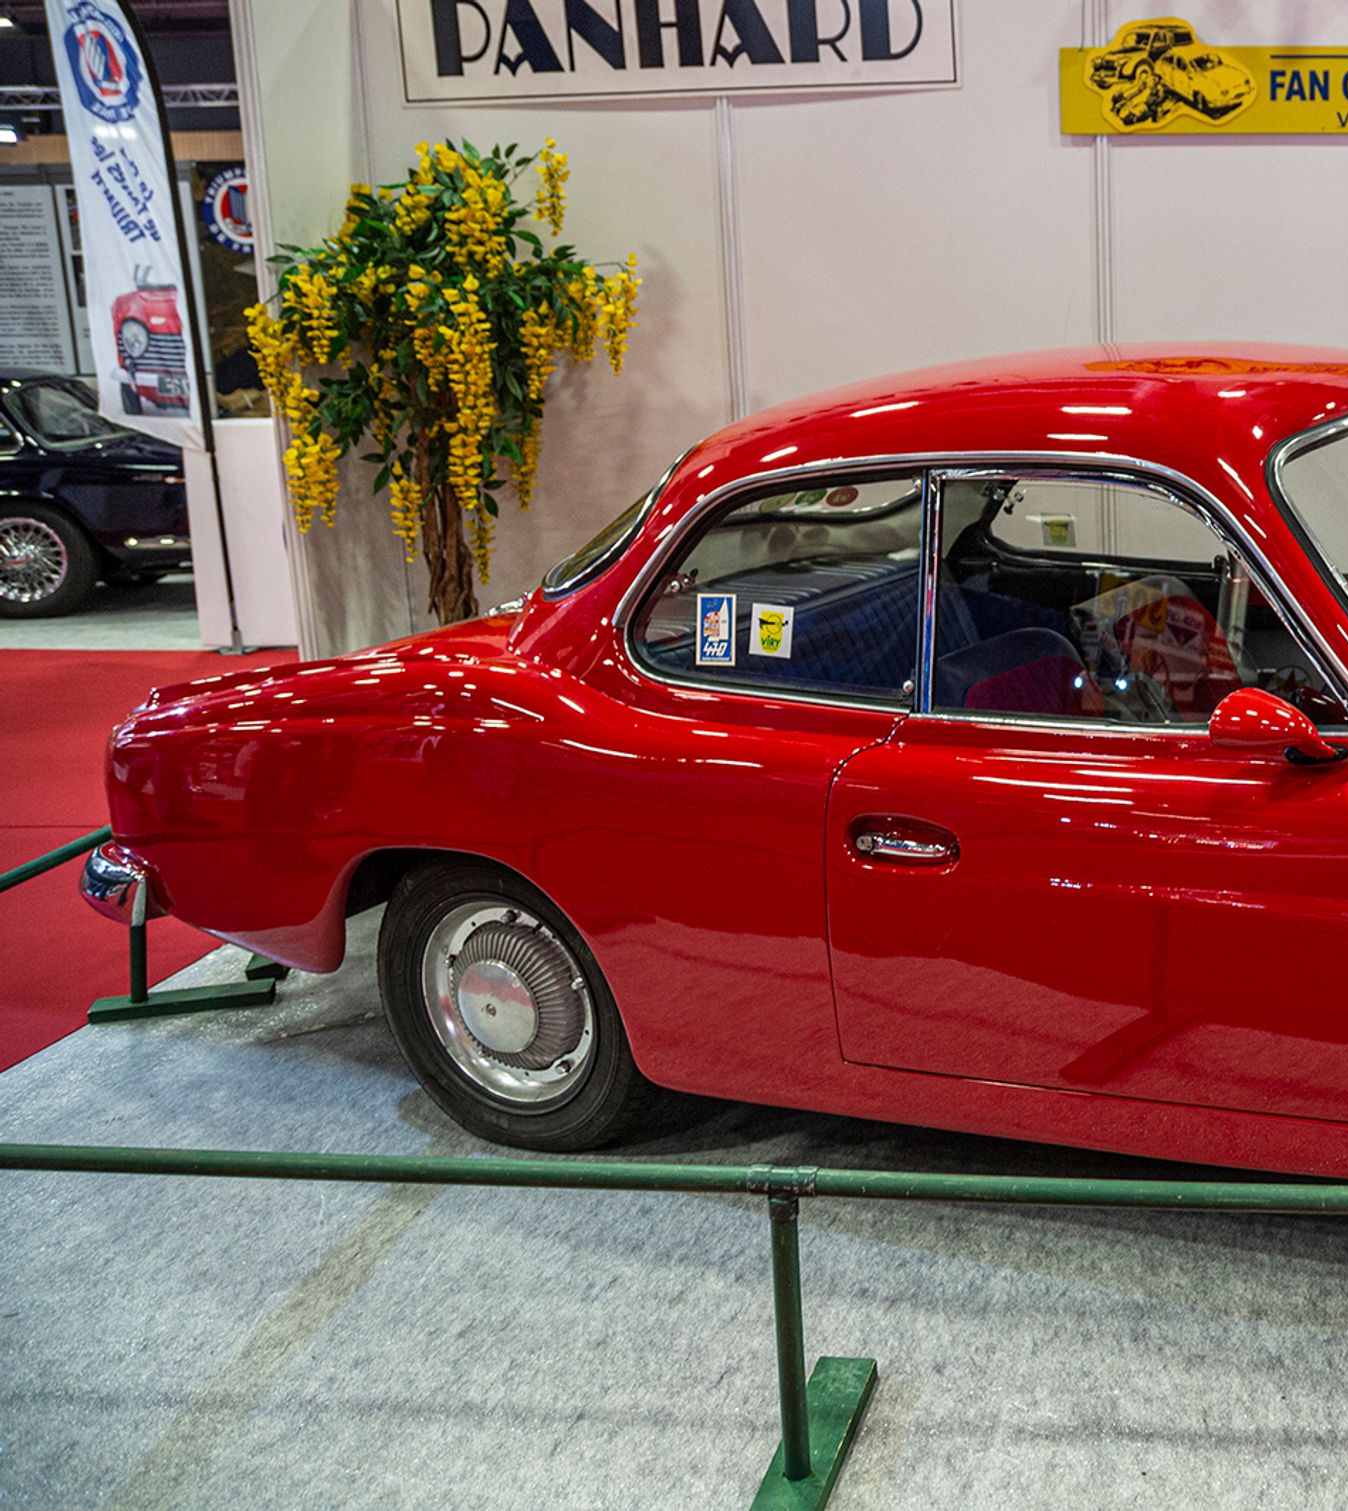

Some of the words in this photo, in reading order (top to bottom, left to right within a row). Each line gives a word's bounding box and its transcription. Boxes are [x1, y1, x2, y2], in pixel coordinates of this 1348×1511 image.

[435, 0, 924, 77] PANHARD
[1270, 70, 1330, 101] FAN
[205, 167, 246, 203] TRIUMP
[703, 642, 728, 657] 470
